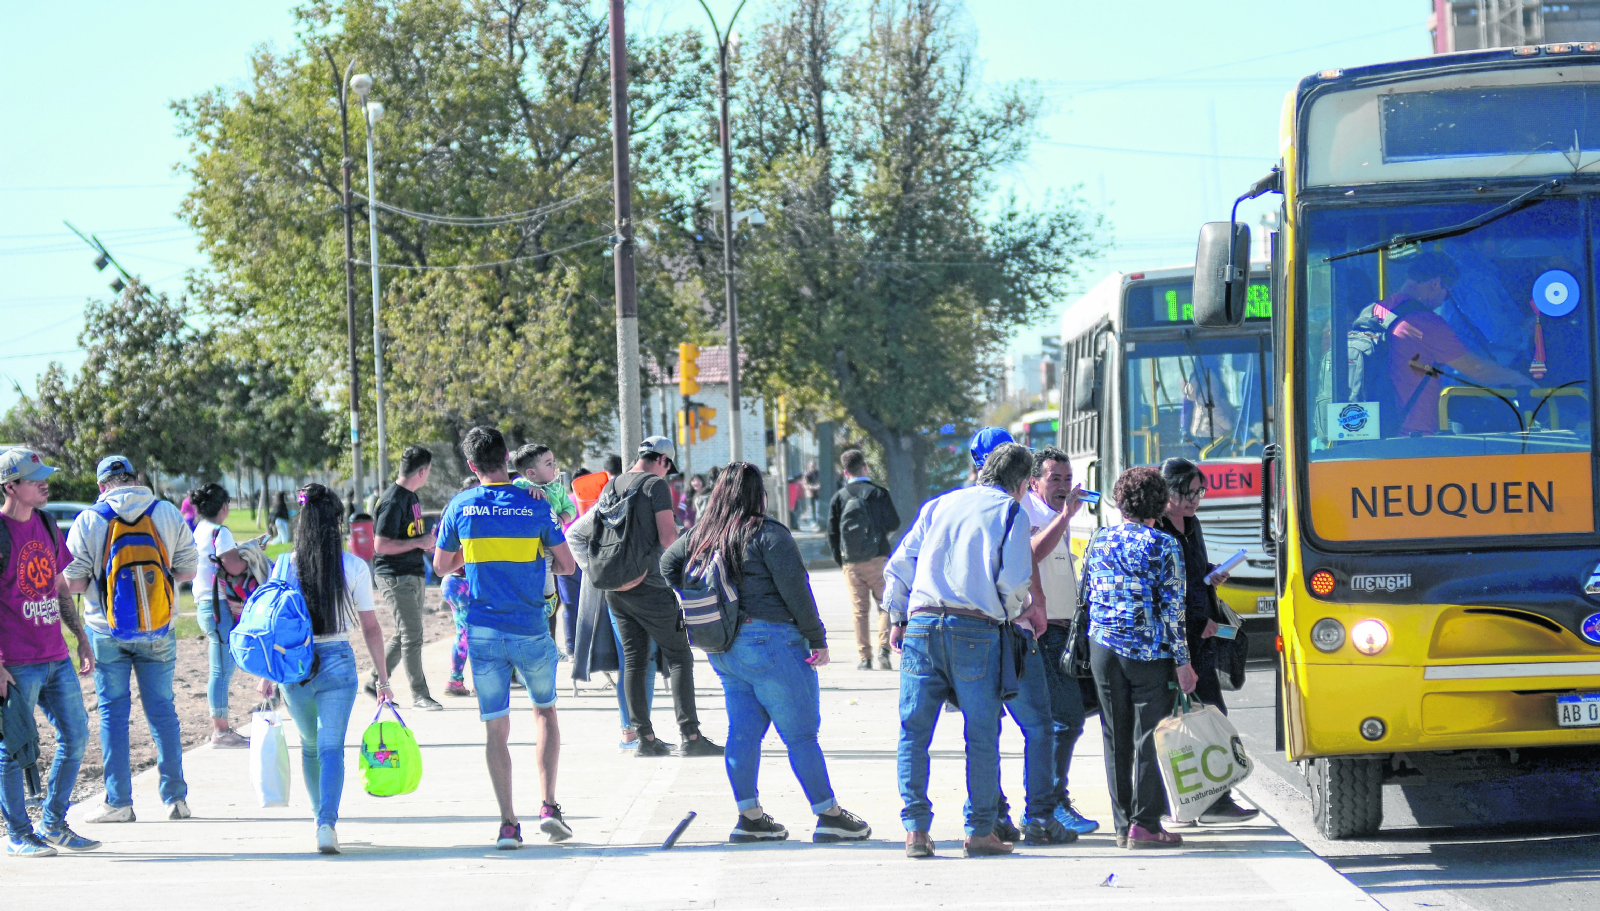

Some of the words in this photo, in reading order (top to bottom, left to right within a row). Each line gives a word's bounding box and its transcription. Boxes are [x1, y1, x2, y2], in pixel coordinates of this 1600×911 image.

[1165, 290, 1177, 321] 1
[1182, 303, 1193, 320] R
[1203, 469, 1253, 490] UÉN
[1351, 481, 1554, 518] NEUQUEN
[463, 505, 490, 516] BBVA
[492, 505, 533, 516] Francés
[1563, 704, 1581, 722] AB
[1179, 797, 1190, 805] La
[1191, 784, 1227, 802] naturaleza
